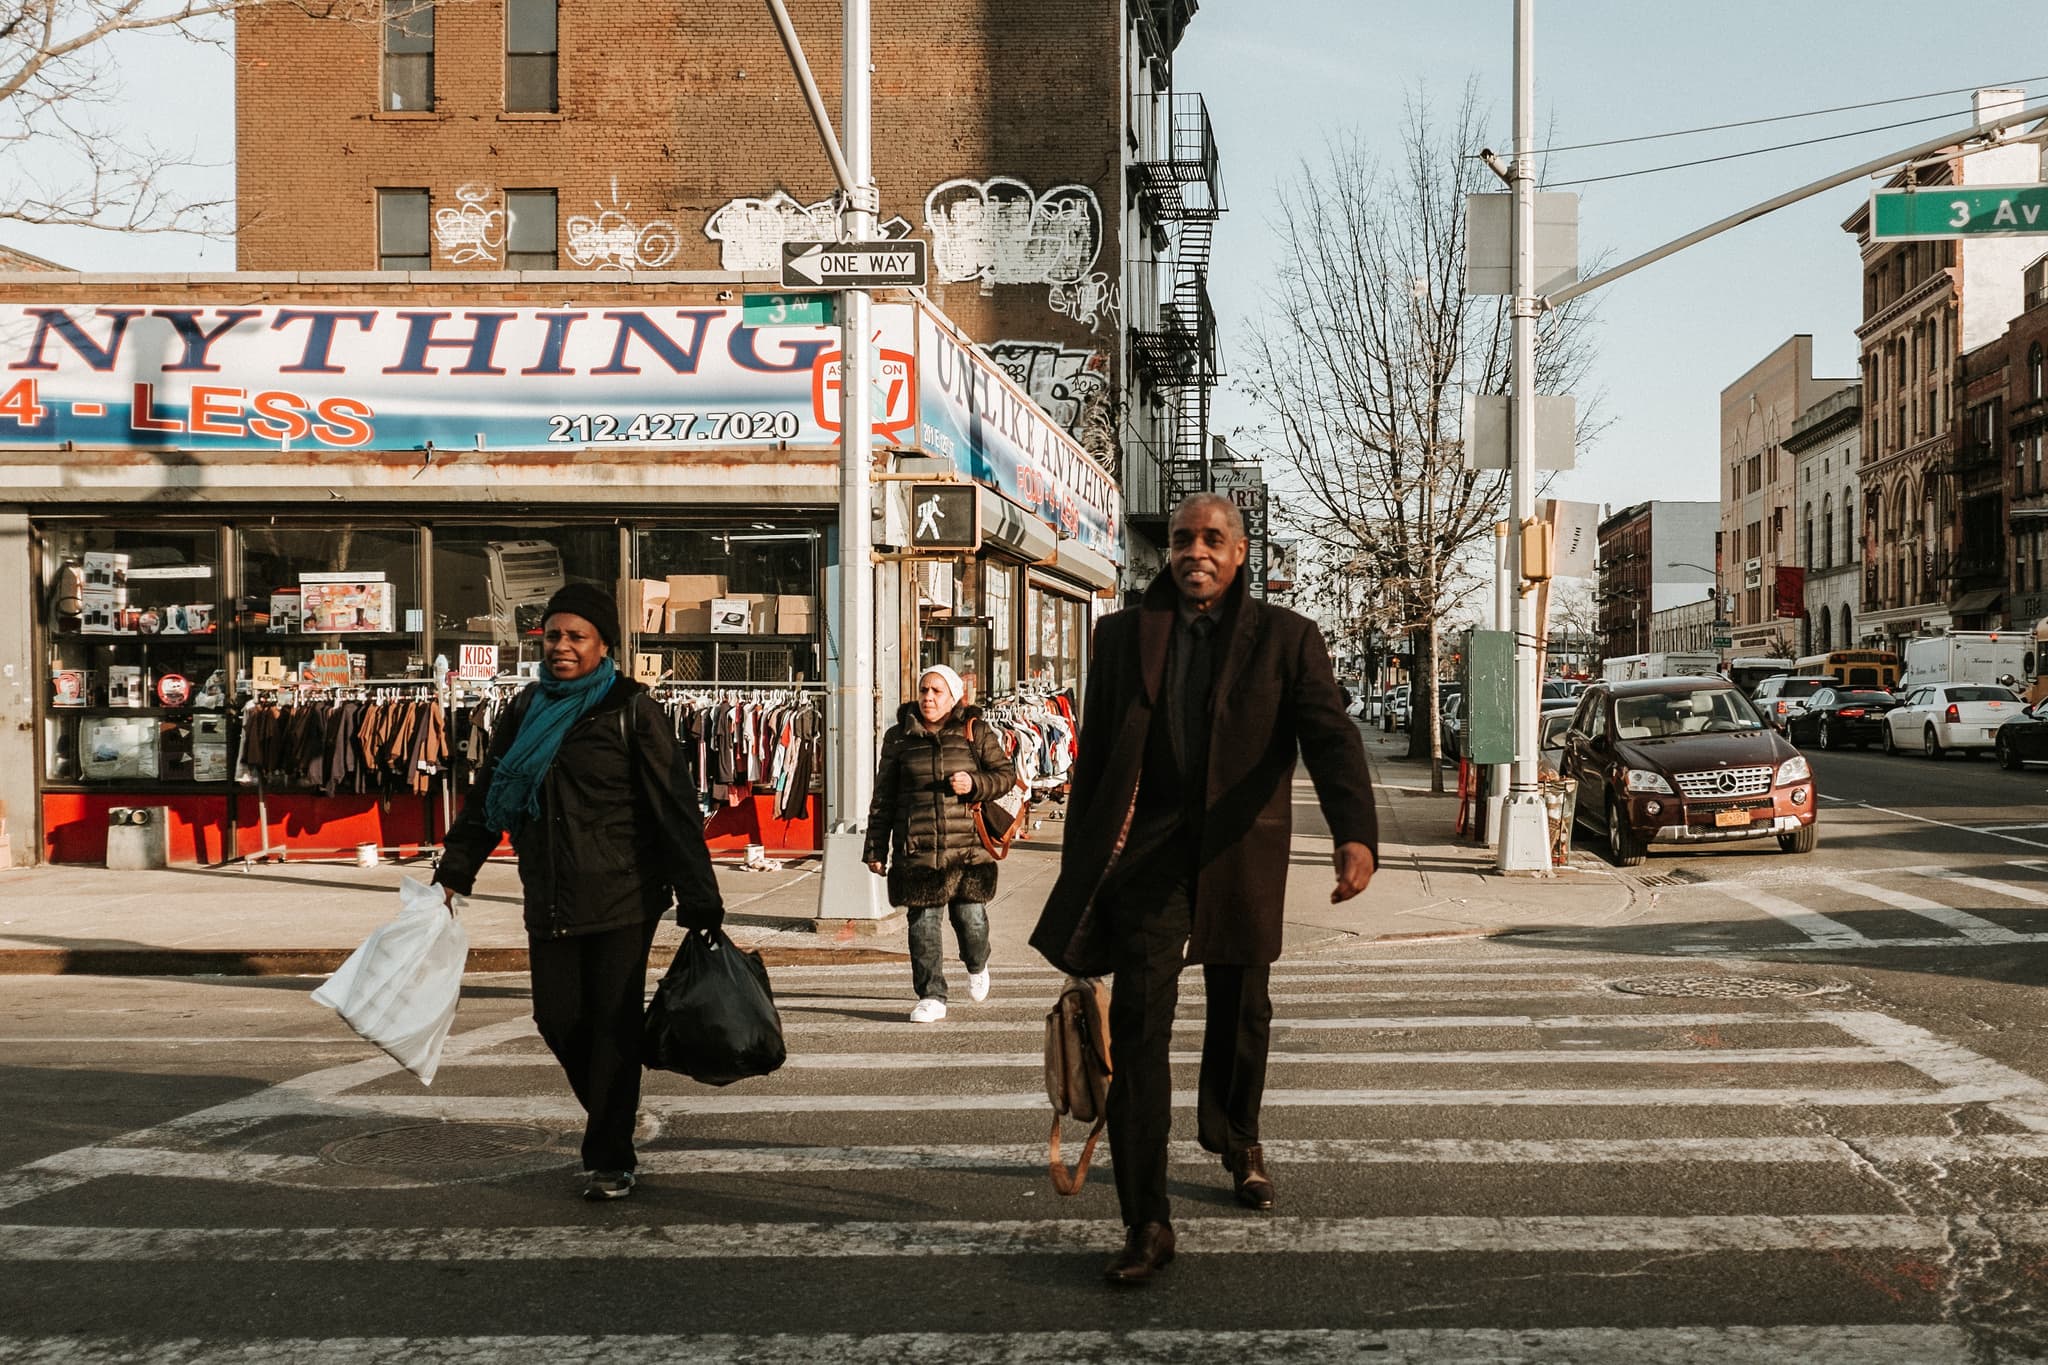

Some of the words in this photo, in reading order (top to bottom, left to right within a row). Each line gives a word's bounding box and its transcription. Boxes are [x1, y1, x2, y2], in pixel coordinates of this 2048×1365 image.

[1949, 201, 1970, 228] 3
[1993, 199, 2041, 226] Av
[820, 255, 858, 273] ONE
[869, 255, 909, 273] WAY
[768, 296, 787, 324] 3
[792, 296, 810, 311] AV
[882, 365, 902, 375] ON
[131, 382, 375, 447] LESS
[548, 411, 799, 442] 212.427.7020
[935, 325, 1036, 459] UNLIKE
[1041, 430, 1115, 519] ANYTHING
[1249, 539, 1264, 600] SERVICE
[315, 654, 346, 667] KIDS
[465, 646, 492, 665] KIDS
[461, 665, 496, 678] CLOTHING
